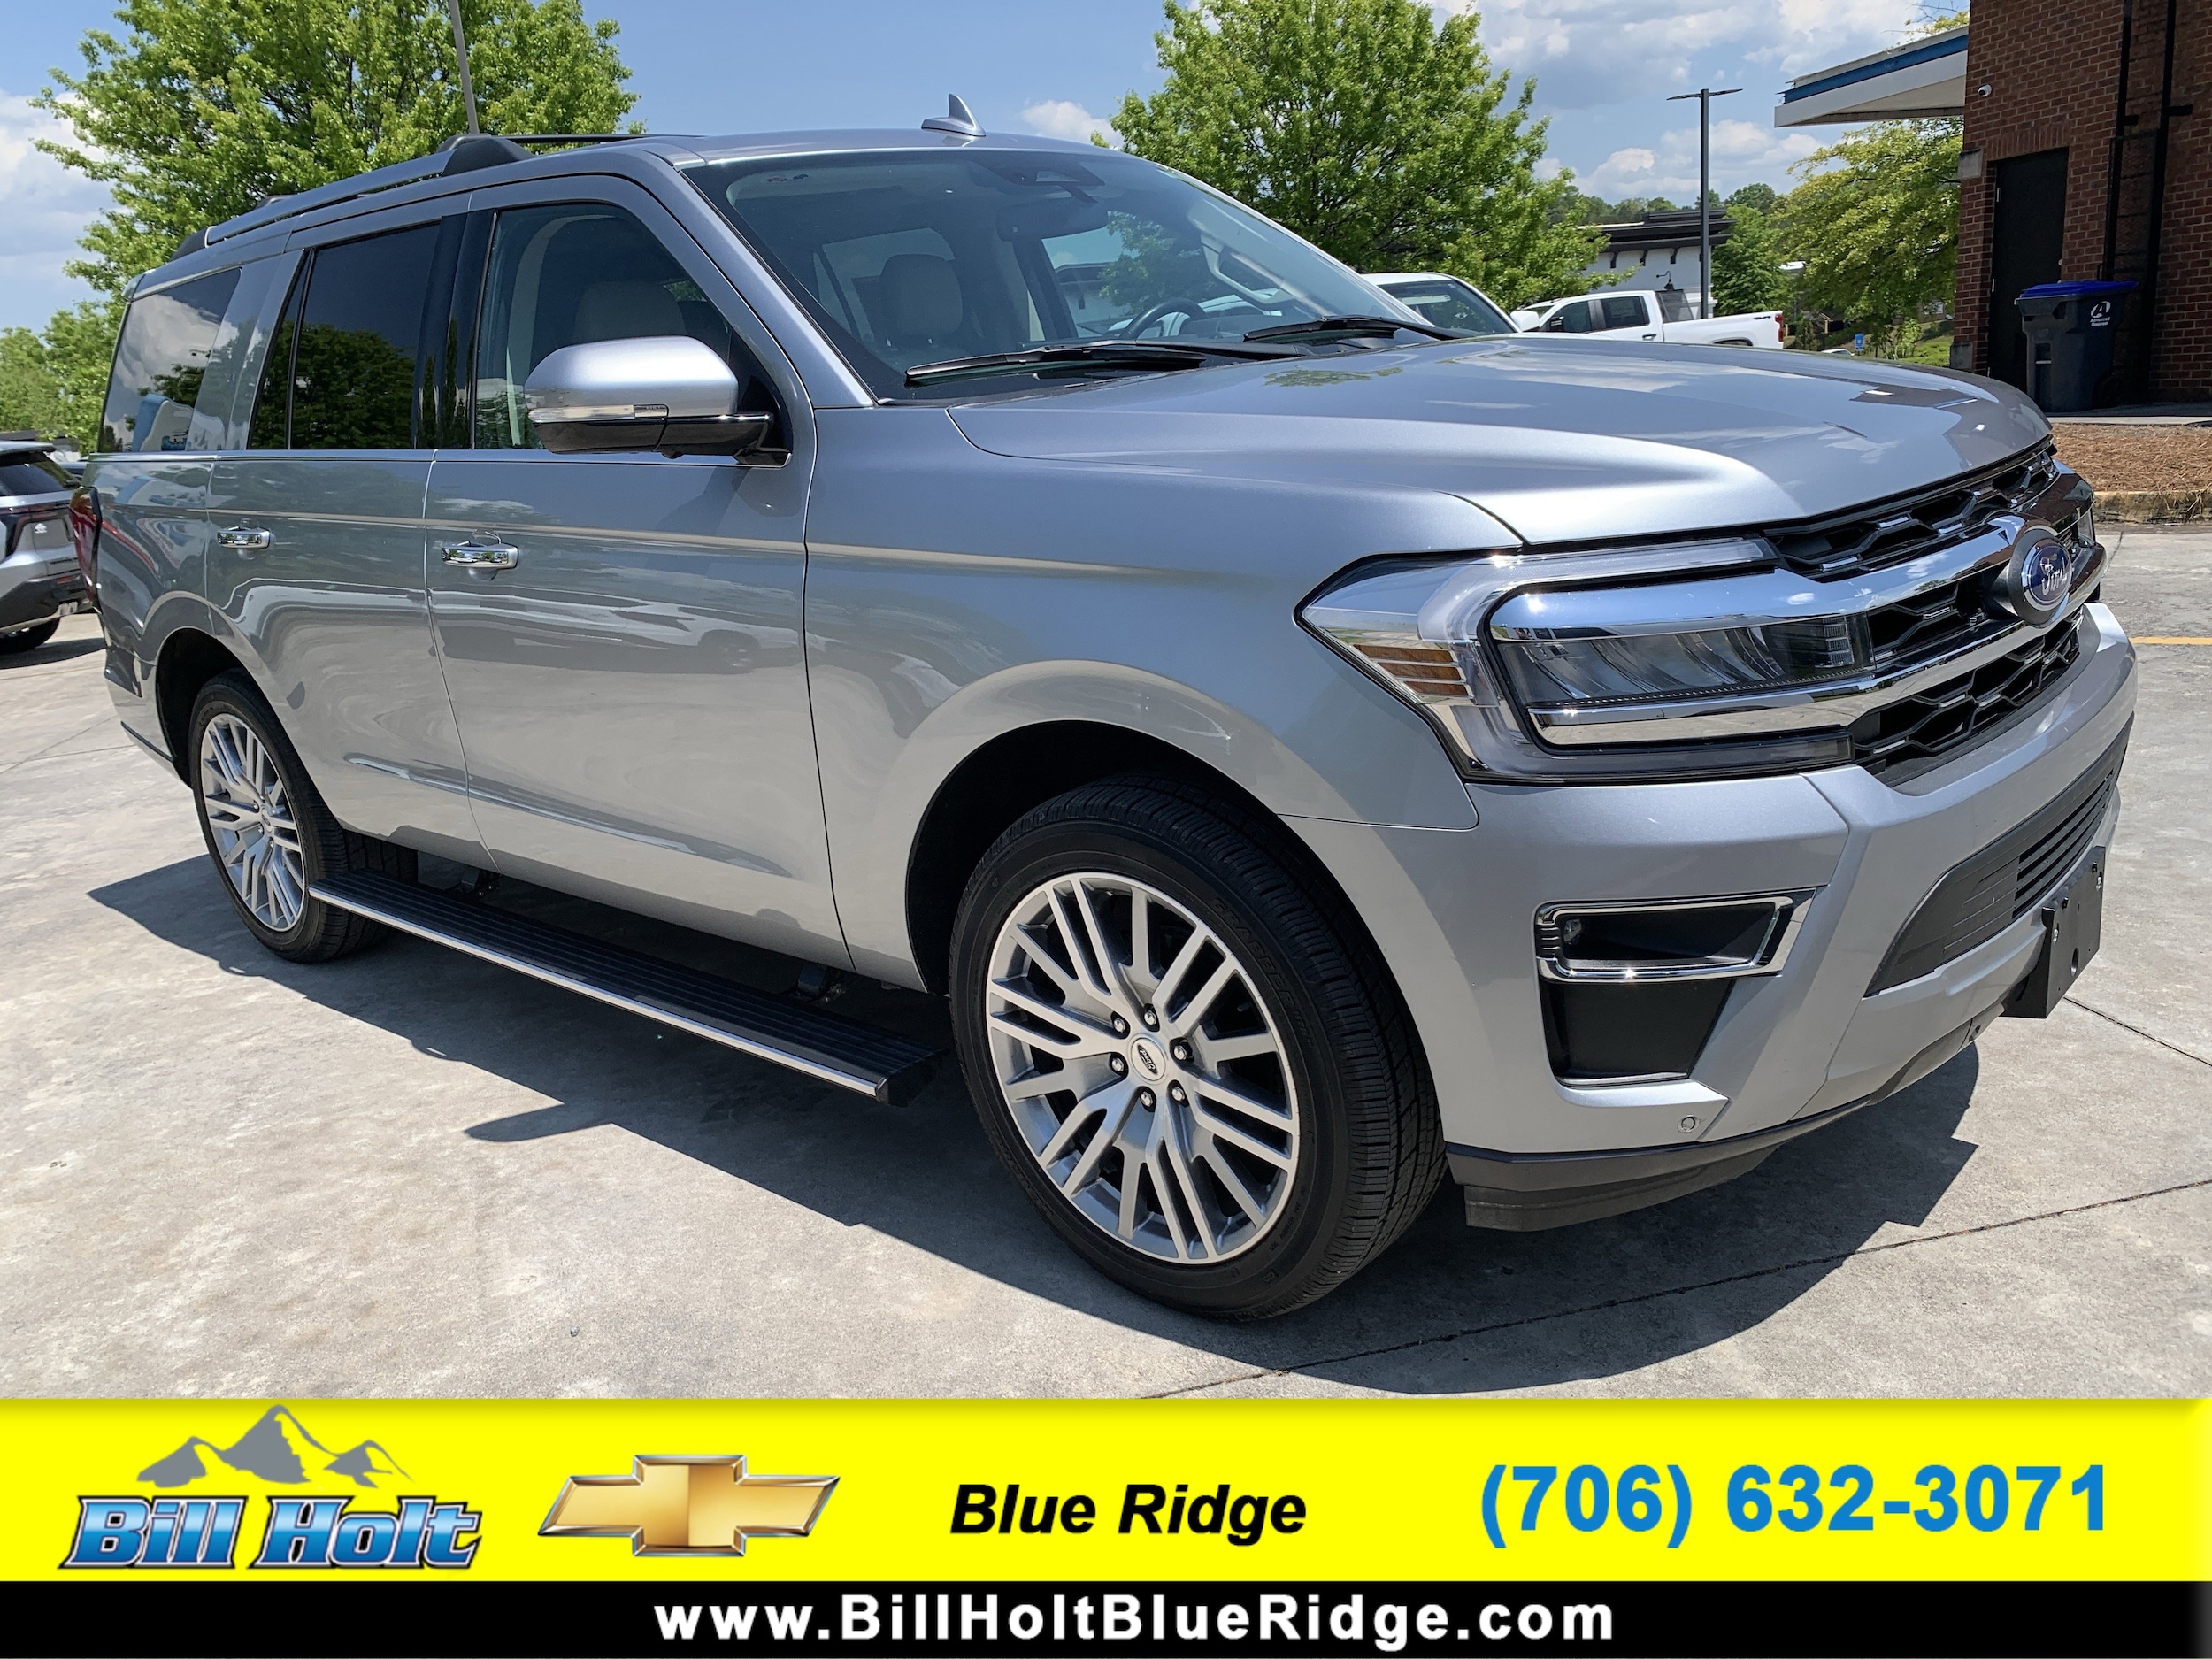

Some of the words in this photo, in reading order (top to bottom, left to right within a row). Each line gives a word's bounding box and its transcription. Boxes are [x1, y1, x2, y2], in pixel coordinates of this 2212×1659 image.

[2039, 557, 2069, 596] Ford
[1210, 897, 1296, 1007] GRABBER
[1139, 1048, 1156, 1071] Ford
